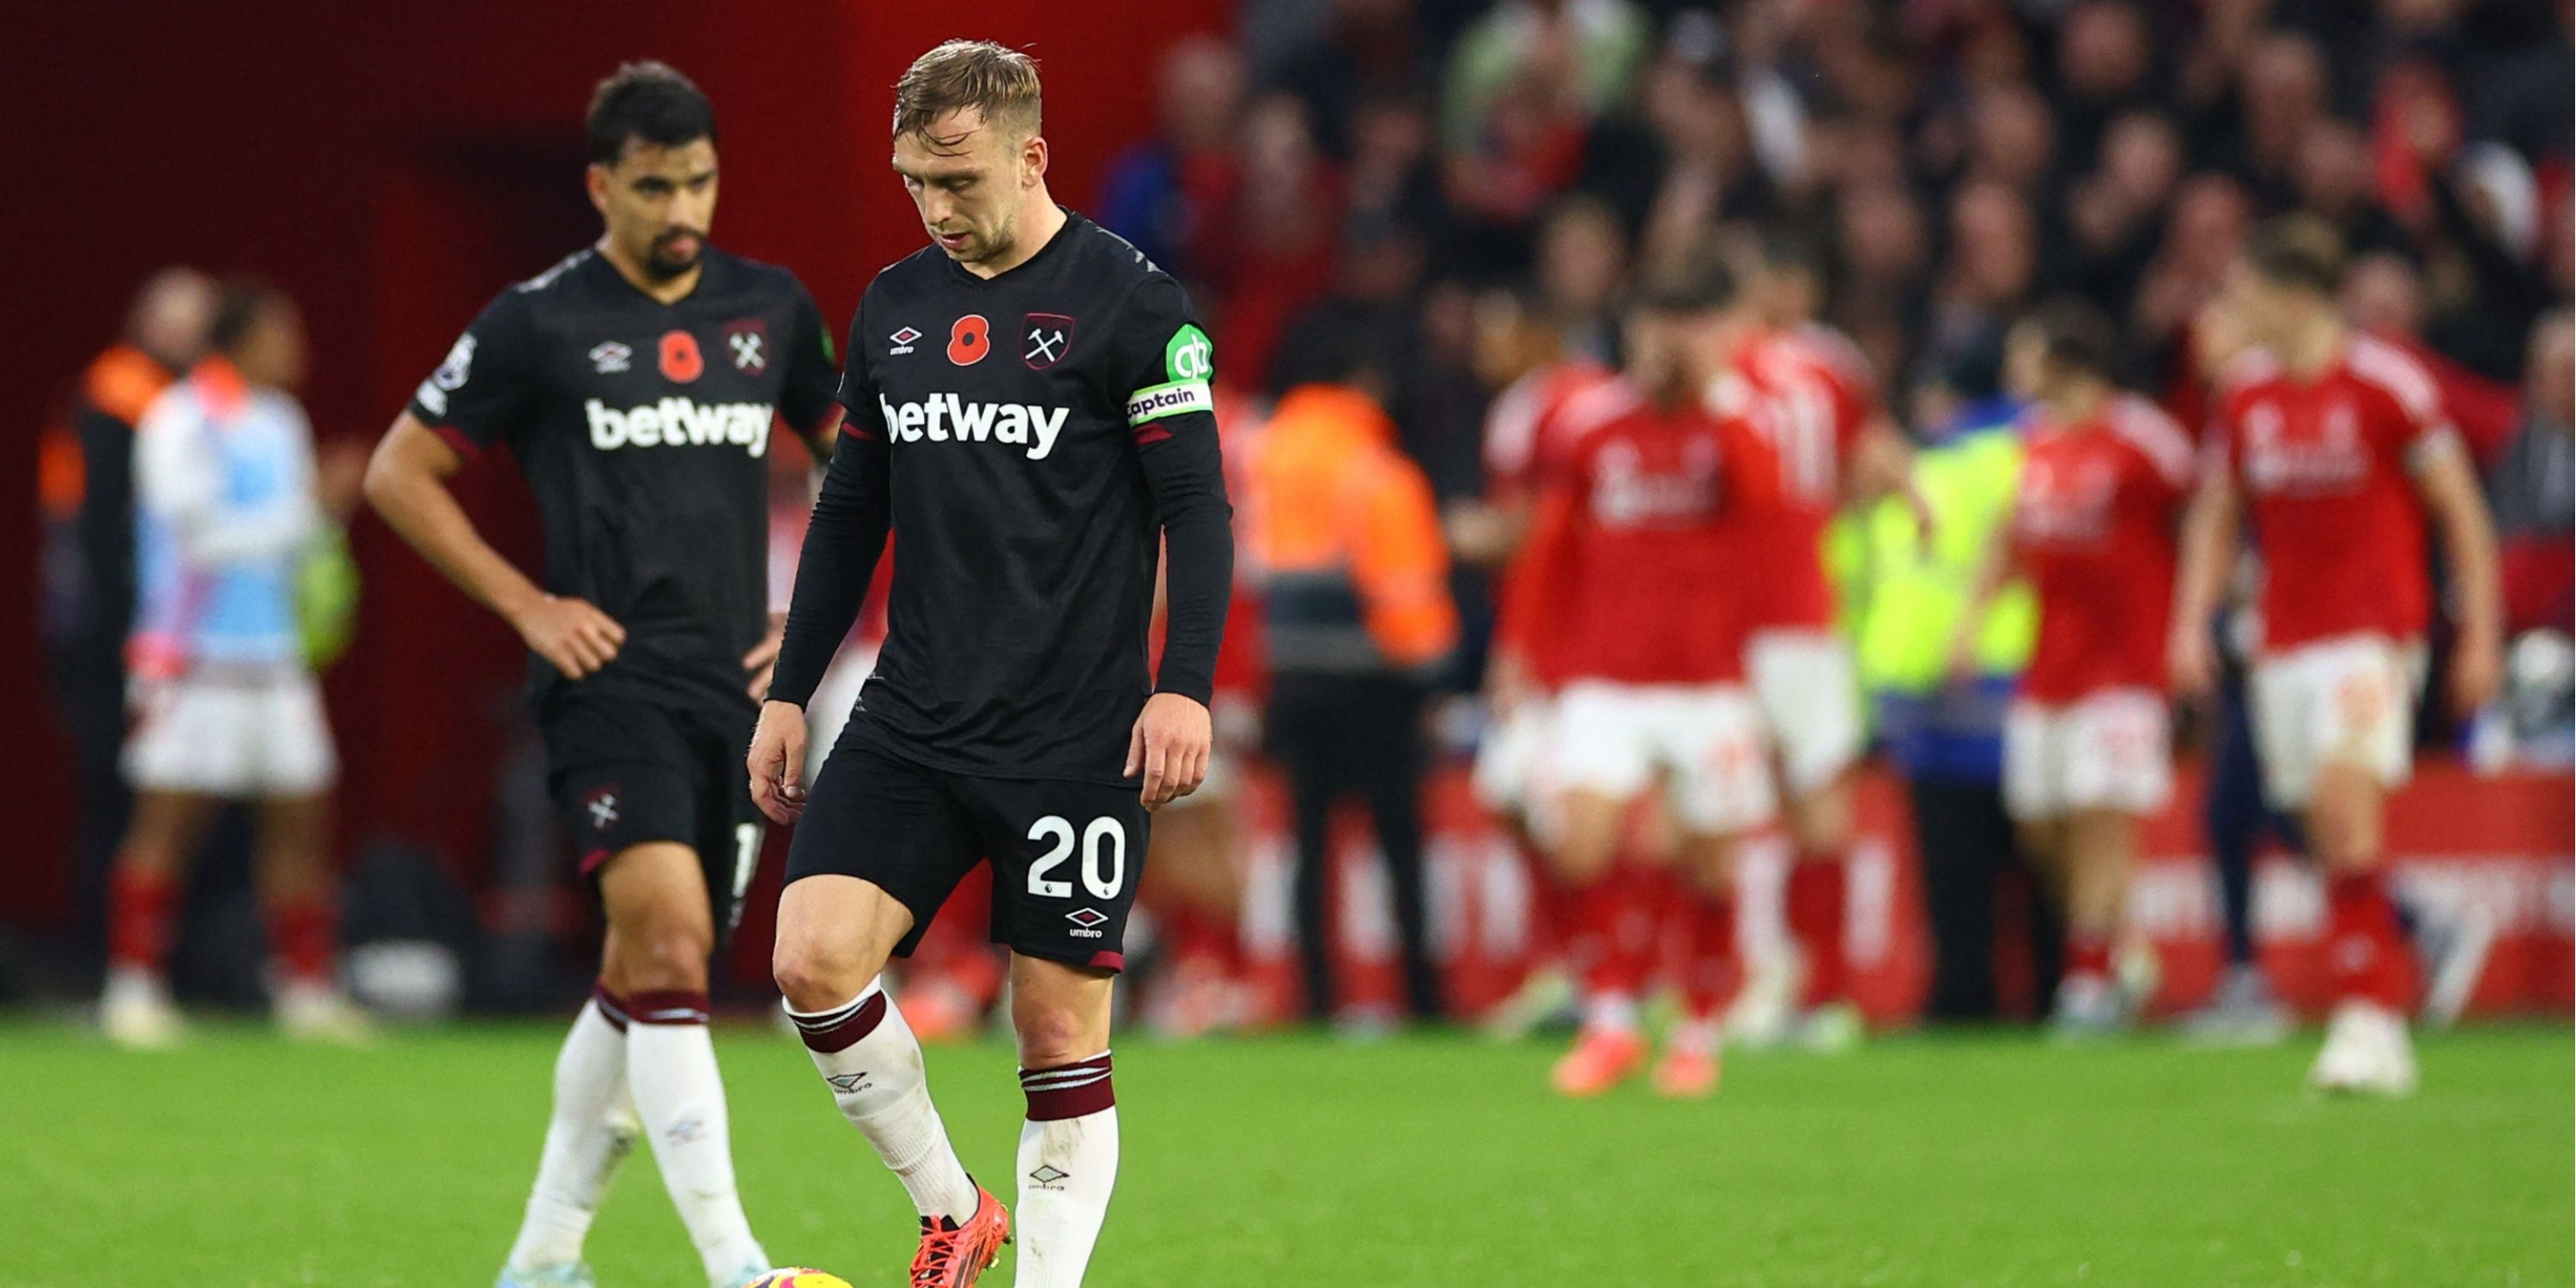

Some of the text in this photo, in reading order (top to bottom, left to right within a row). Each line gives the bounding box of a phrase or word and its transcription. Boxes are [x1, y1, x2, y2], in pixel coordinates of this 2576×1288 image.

[585, 396, 775, 458] betway
[878, 392, 1071, 460] betway
[732, 822, 765, 898] 1
[1027, 815, 1126, 900] 20
[1069, 927, 1103, 939] umbro
